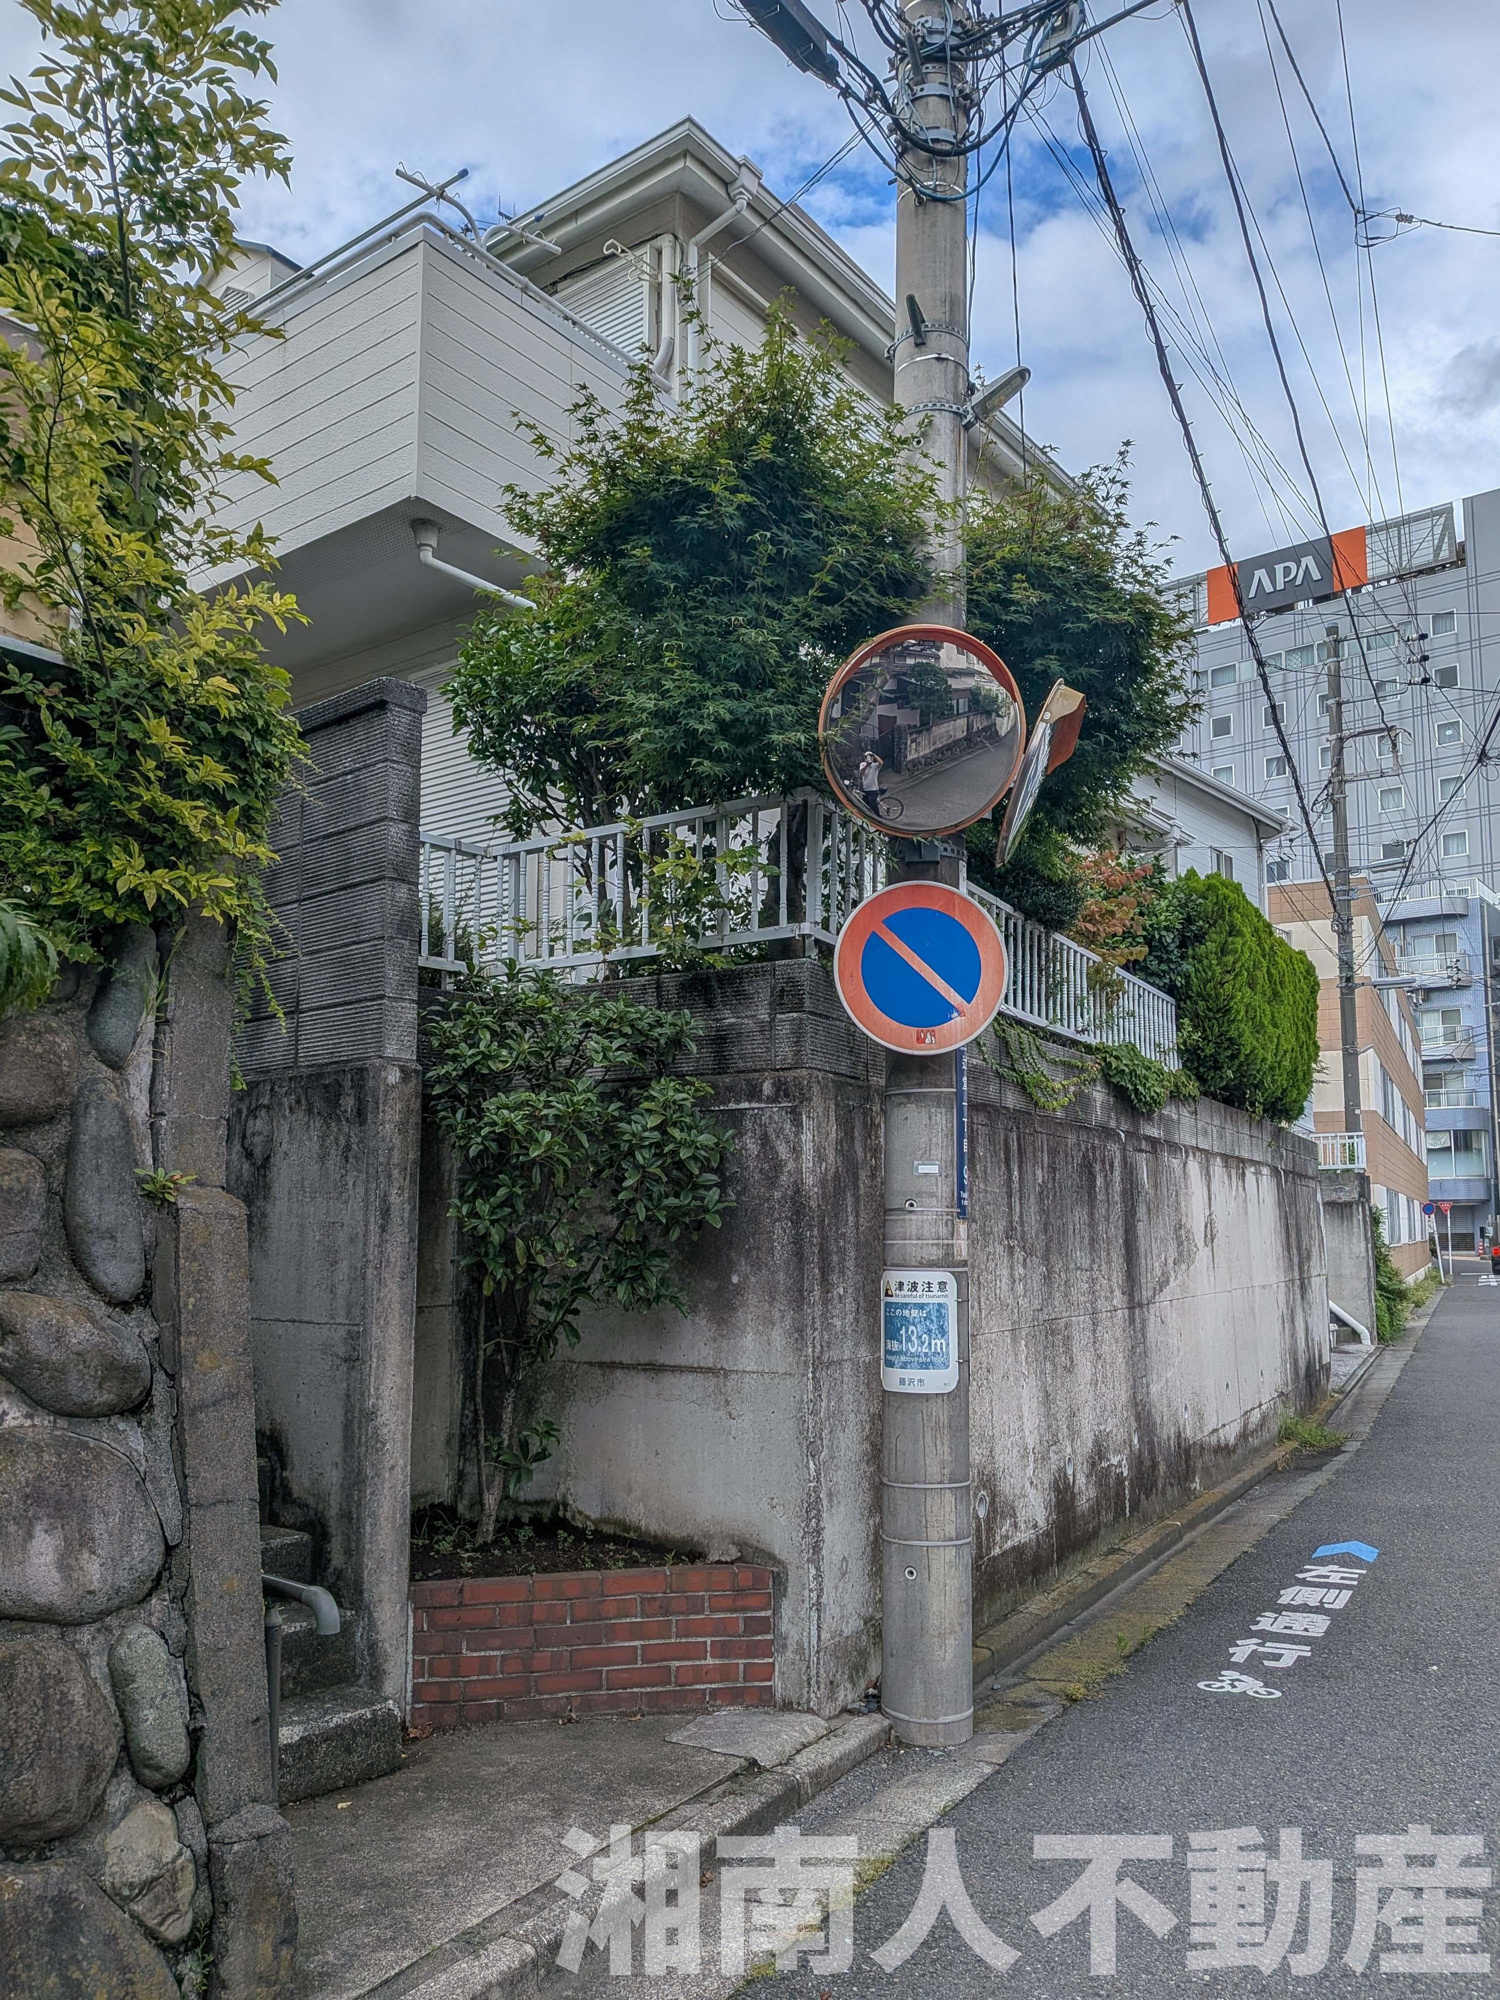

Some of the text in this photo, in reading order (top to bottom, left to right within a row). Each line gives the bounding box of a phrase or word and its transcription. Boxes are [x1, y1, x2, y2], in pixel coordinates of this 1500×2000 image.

[1248, 555, 1322, 599] APA
[894, 1280, 949, 1293] 津波注意
[886, 1308, 927, 1318] ここの地盤は
[886, 1325, 946, 1353] 海抜 13.2m
[899, 1377, 926, 1387] 藤沢市
[1229, 1564, 1368, 1668] 左側通行
